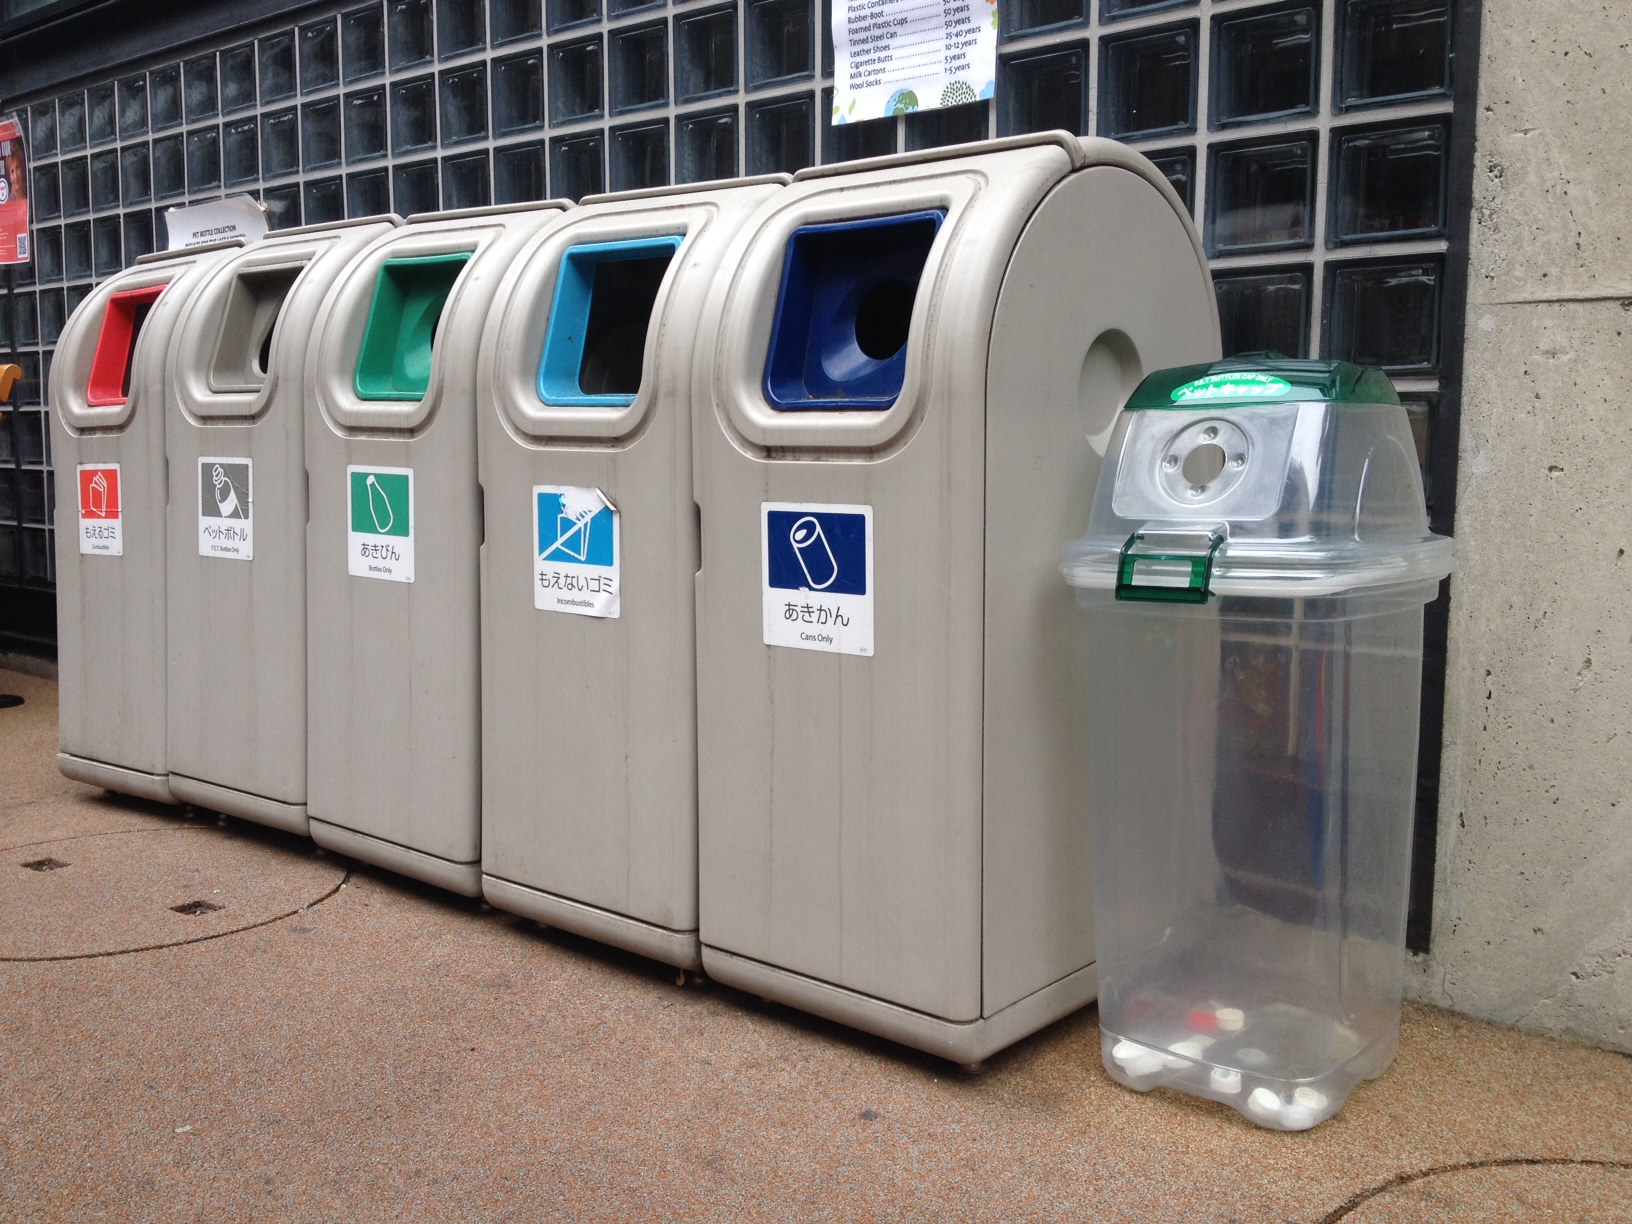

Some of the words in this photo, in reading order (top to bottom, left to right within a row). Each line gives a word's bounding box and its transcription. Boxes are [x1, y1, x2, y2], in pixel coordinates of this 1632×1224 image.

[848, 3, 866, 13] Plastic
[848, 11, 884, 24] Rubber-Boot
[848, 23, 871, 35] Foamed
[872, 20, 892, 30] Plastic
[893, 17, 908, 27] Cups
[944, 8, 951, 17] 50
[952, 4, 969, 16] years
[849, 36, 869, 46] Tinned
[870, 32, 884, 43] Steel
[886, 31, 897, 40] Can
[945, 20, 952, 29] 50
[953, 16, 970, 28] years
[850, 47, 871, 58] Leather
[873, 44, 890, 54] Shoes
[945, 30, 963, 40] 25-40
[964, 26, 981, 38] years
[850, 58, 876, 70] Cigarette
[877, 55, 893, 63] Butts
[945, 42, 960, 50] 10-12
[960, 38, 977, 50] years
[850, 71, 862, 80] Milk
[864, 67, 886, 77] Cartons
[949, 52, 966, 64] years
[849, 81, 864, 90] Wool
[865, 78, 881, 88] Socks
[944, 66, 953, 75] 1-5
[953, 63, 970, 75] years
[192, 231, 200, 239] PET
[200, 228, 213, 238] BOTTLE
[214, 224, 236, 235] COLLECTION
[85, 525, 116, 539] もえるゴミ
[203, 525, 248, 542] ペットボトル
[360, 542, 400, 561] あきびん
[383, 566, 392, 575] Only
[539, 571, 613, 595] もえないゴミ
[556, 597, 594, 608] Incombustibles
[784, 602, 850, 627] あきかん
[800, 632, 816, 642] Cans
[817, 634, 833, 645] Only
